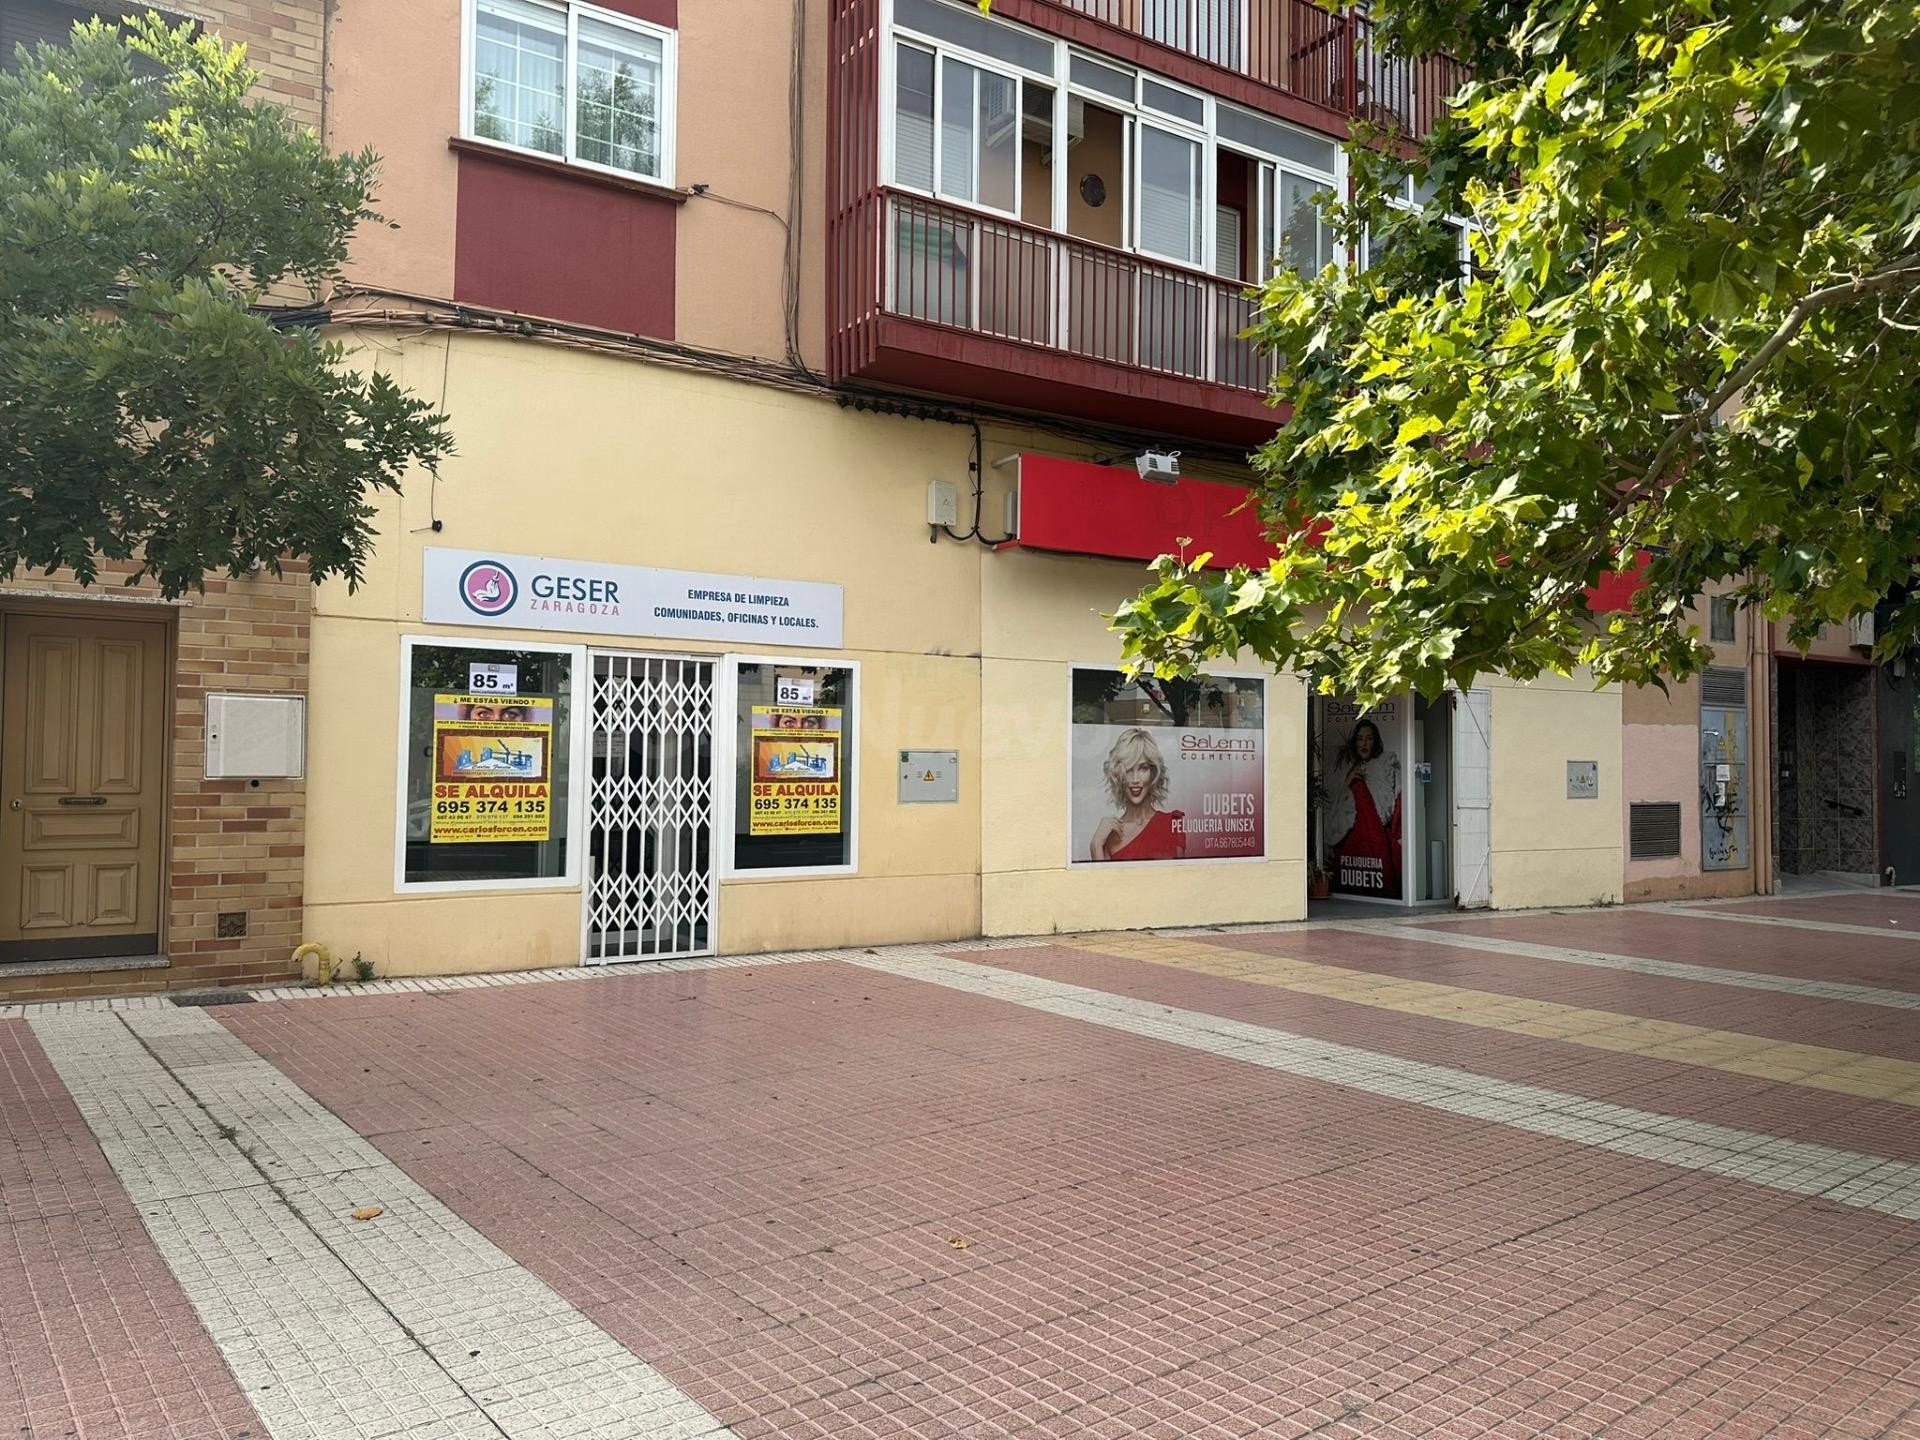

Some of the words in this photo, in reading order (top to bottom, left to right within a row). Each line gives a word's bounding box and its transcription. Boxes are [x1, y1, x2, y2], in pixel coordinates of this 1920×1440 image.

[530, 574, 620, 603] GESER
[687, 588, 732, 604] EMPRESA
[734, 591, 747, 604] DE
[748, 592, 790, 607] LIMPIEZA
[530, 598, 620, 616] ZARAGOZA
[653, 606, 725, 622] COMUNIDADES,
[727, 611, 769, 625] OFICINAS
[770, 614, 778, 625] Y
[778, 614, 820, 629] LOCALES.
[473, 673, 498, 689] 85
[780, 687, 799, 700] 85
[1181, 734, 1255, 750] Salerm
[1181, 752, 1256, 760] COSMETICS
[435, 784, 460, 798] SE
[465, 784, 548, 798] ALQUILA
[753, 784, 772, 796] SE
[776, 784, 839, 796] ALQUILA
[437, 801, 470, 813] 695
[476, 801, 508, 813] 374
[514, 801, 545, 813] 135
[754, 798, 780, 809] 695
[784, 798, 809, 809] 374
[813, 798, 837, 808] 135
[1203, 793, 1255, 815] DUBETS
[434, 825, 548, 834] www.carlosforcen.com
[1171, 818, 1223, 833] PELUQUERIA
[1225, 818, 1255, 832] UNISEX
[1340, 855, 1383, 869] PELUQUERIA
[1340, 869, 1384, 889] DUBETS
